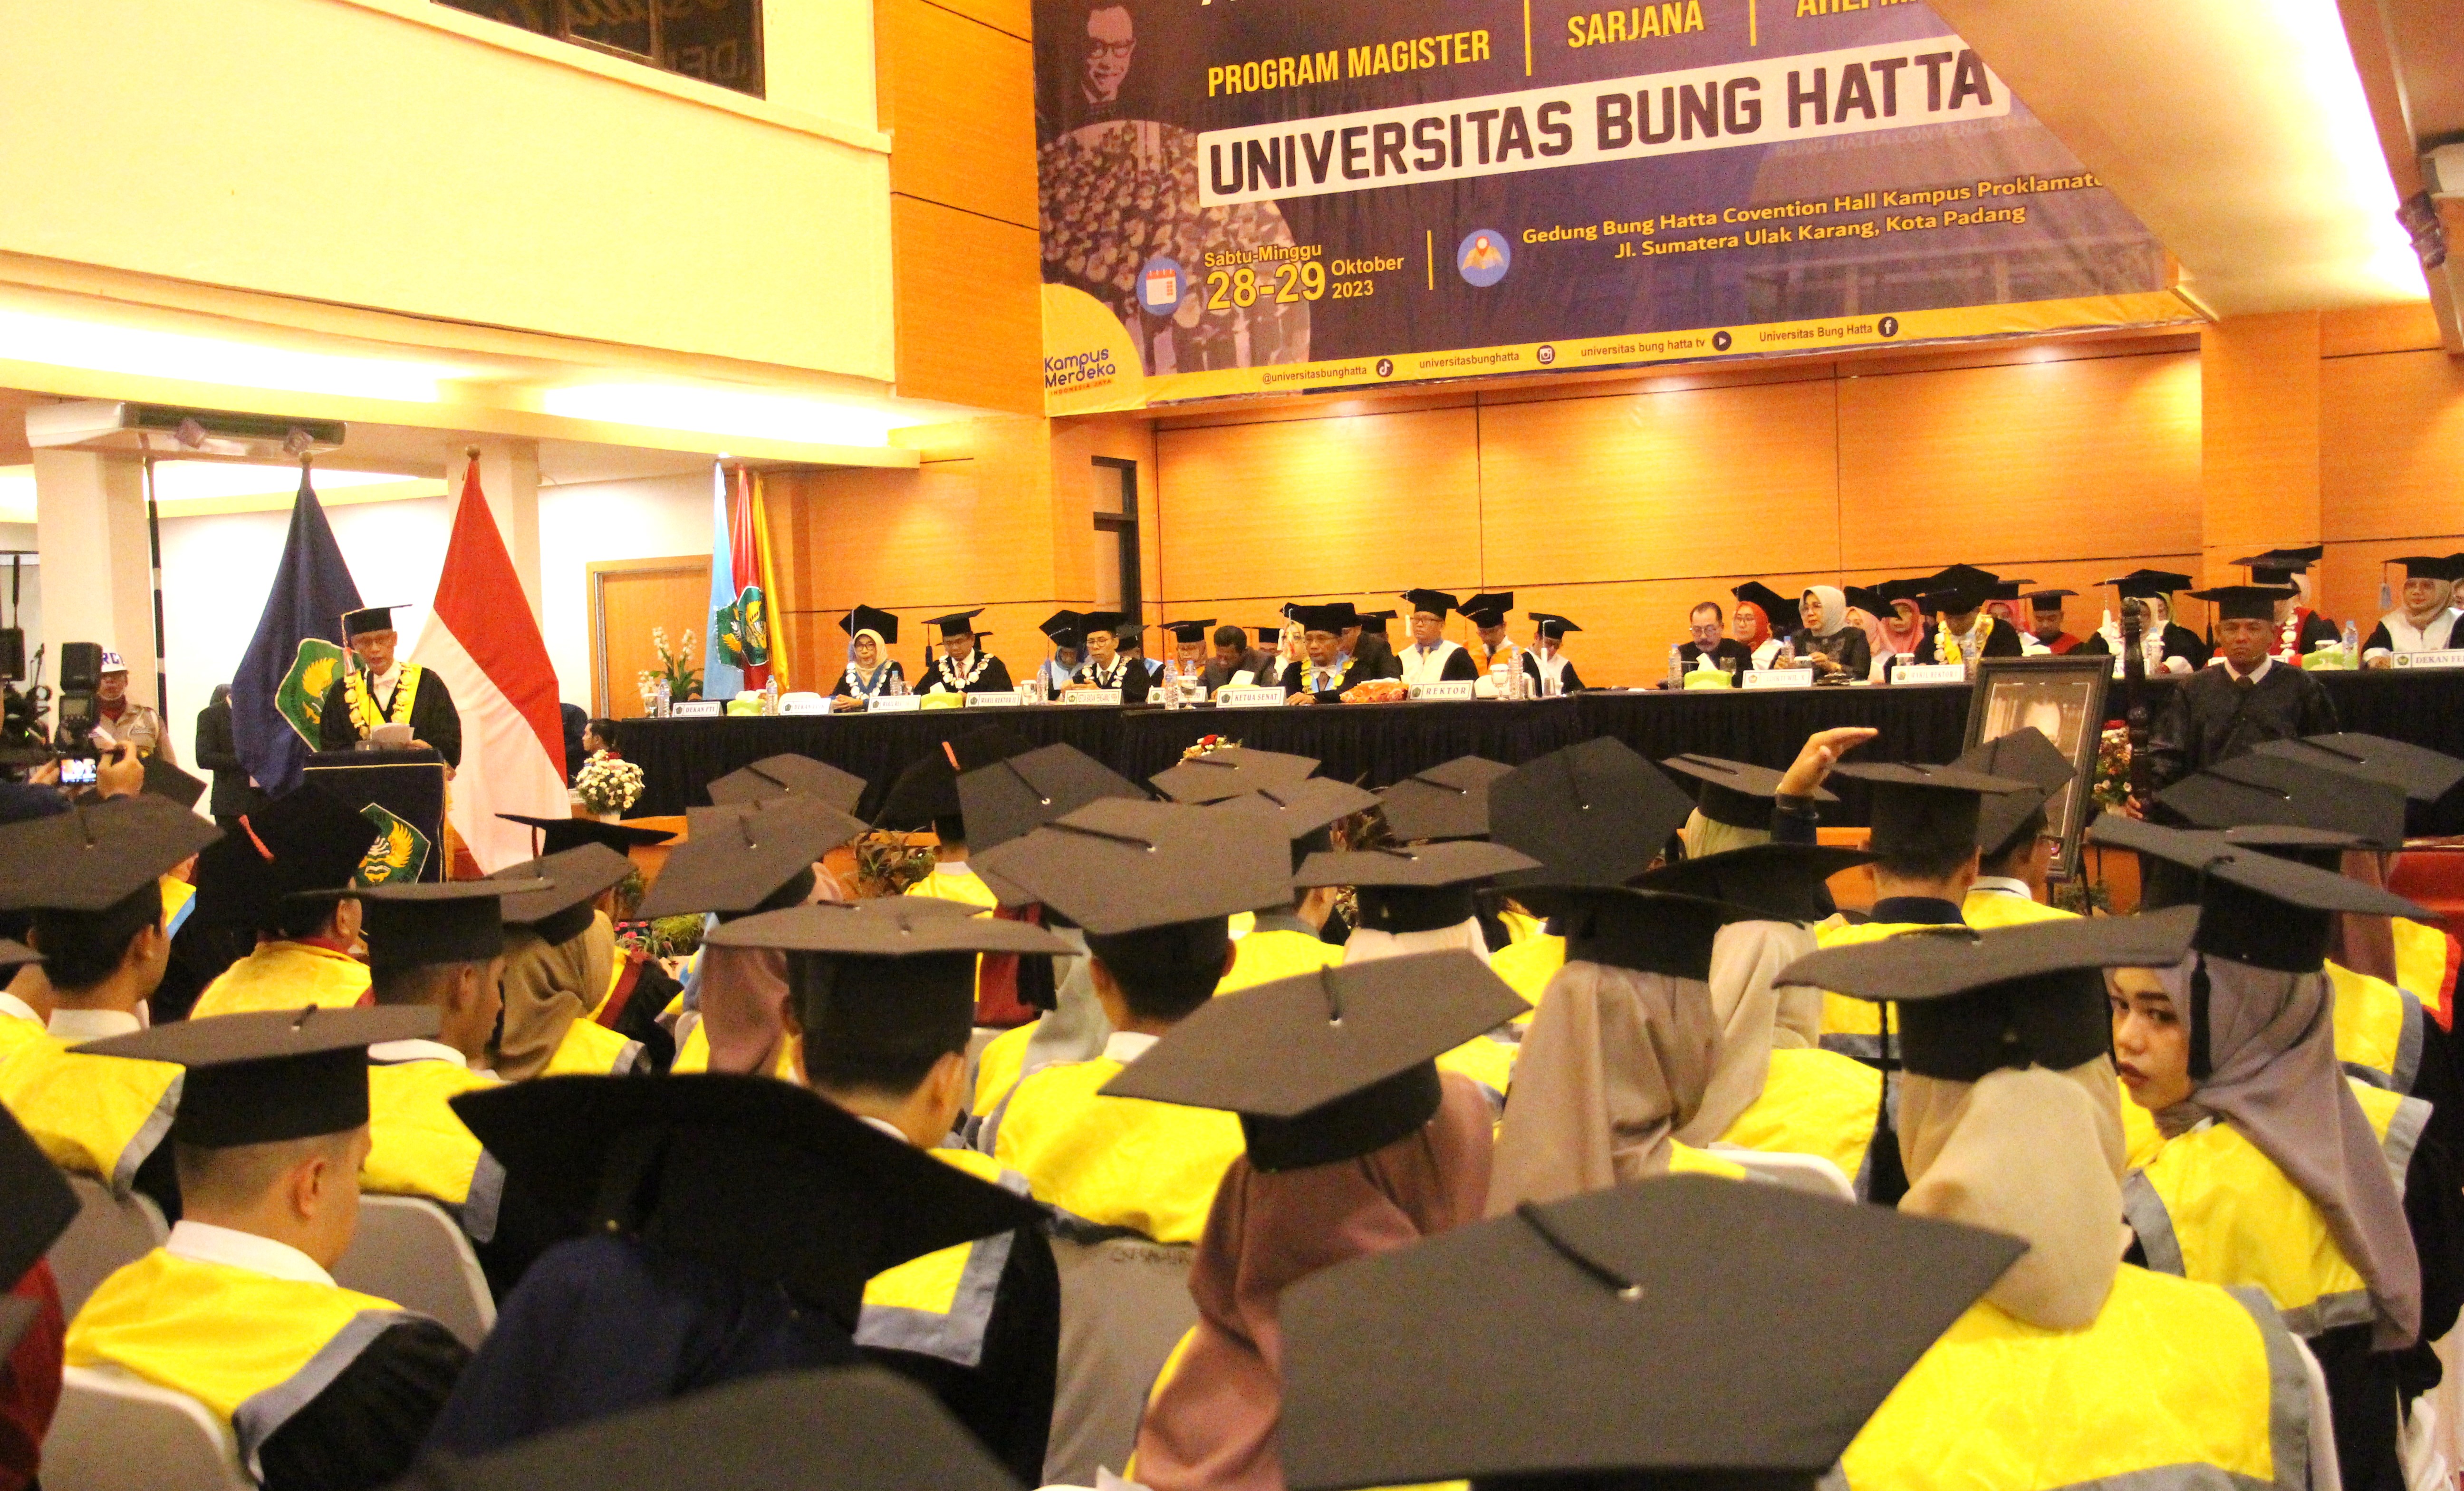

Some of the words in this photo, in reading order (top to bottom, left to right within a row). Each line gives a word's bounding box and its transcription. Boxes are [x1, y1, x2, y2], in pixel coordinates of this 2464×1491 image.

[1568, 0, 1704, 48] SARJANA
[1208, 50, 1338, 97] PROGRAM
[1348, 29, 1490, 78] MAGISTER
[1210, 100, 1572, 195] UNIVERSITAS
[1595, 76, 1761, 151] BUNG
[1787, 48, 1993, 129] HATTA
[1522, 225, 1598, 243] Gedung
[1603, 218, 1655, 236] Bung
[1660, 212, 1717, 230] Hatta
[1723, 200, 1827, 223] Covention
[1834, 192, 1876, 213] Hall
[1883, 186, 1971, 206] Kampus
[1614, 242, 1636, 259] Jl.
[1642, 236, 1739, 256] Sumatera
[1745, 226, 1792, 246] Ulak
[1799, 220, 1880, 241] Karang,
[1886, 214, 1937, 232] Kota
[1944, 206, 2026, 226] Padang
[1204, 244, 1322, 268] Sabtu-Minggu
[1331, 257, 1405, 276] Oktober
[1206, 261, 1327, 310] 28-29
[1332, 280, 1374, 299] 2023
[1760, 329, 1814, 342] Universitas
[1818, 327, 1843, 338] Bung
[1847, 324, 1872, 335] Hatta
[1581, 344, 1635, 357] universitas
[1639, 342, 1664, 353] bung
[1667, 339, 1693, 350] hatta
[1696, 338, 1705, 347] tv
[1044, 349, 1109, 373] Kampus
[1419, 352, 1520, 368] universitasbunghatta
[1045, 363, 1116, 389] Merdeka
[1051, 384, 1090, 396] INDONESIA
[1094, 379, 1112, 387] JAYA
[1262, 366, 1367, 385] @universitasbunghatta
